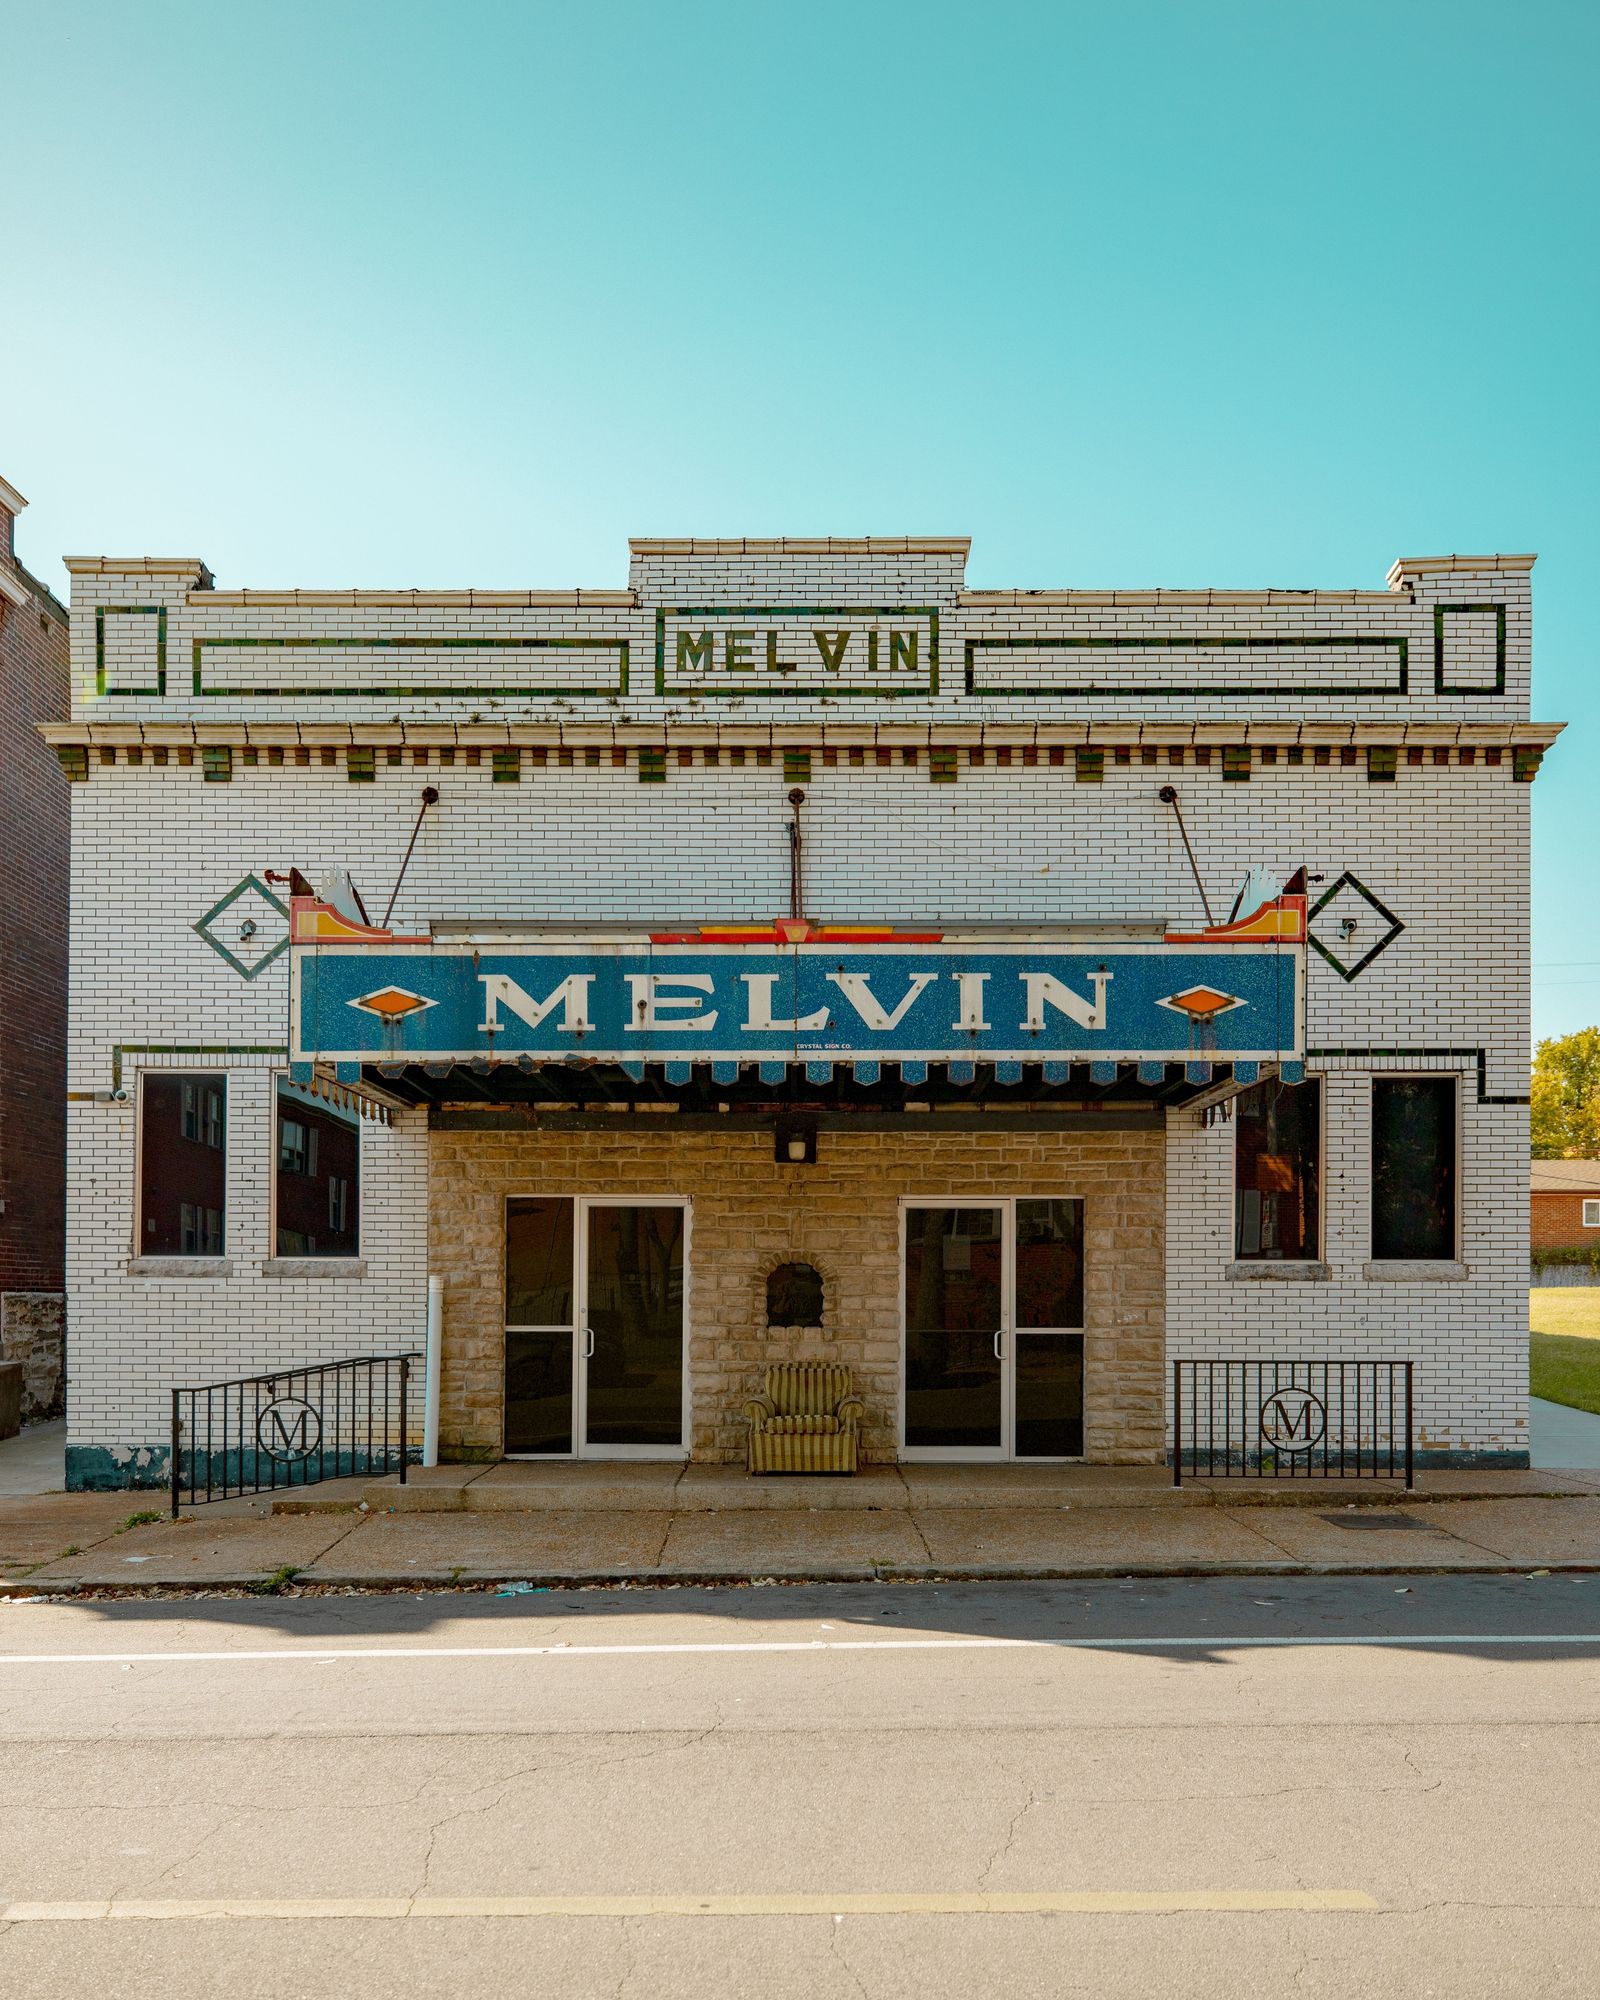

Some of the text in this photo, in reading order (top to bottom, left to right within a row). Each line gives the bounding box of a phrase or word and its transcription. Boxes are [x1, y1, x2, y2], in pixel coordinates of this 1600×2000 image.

[677, 630, 918, 671] MELVIN
[477, 972, 1114, 1032] MELVIN
[268, 1410, 312, 1450] M
[1271, 1400, 1314, 1440] M
